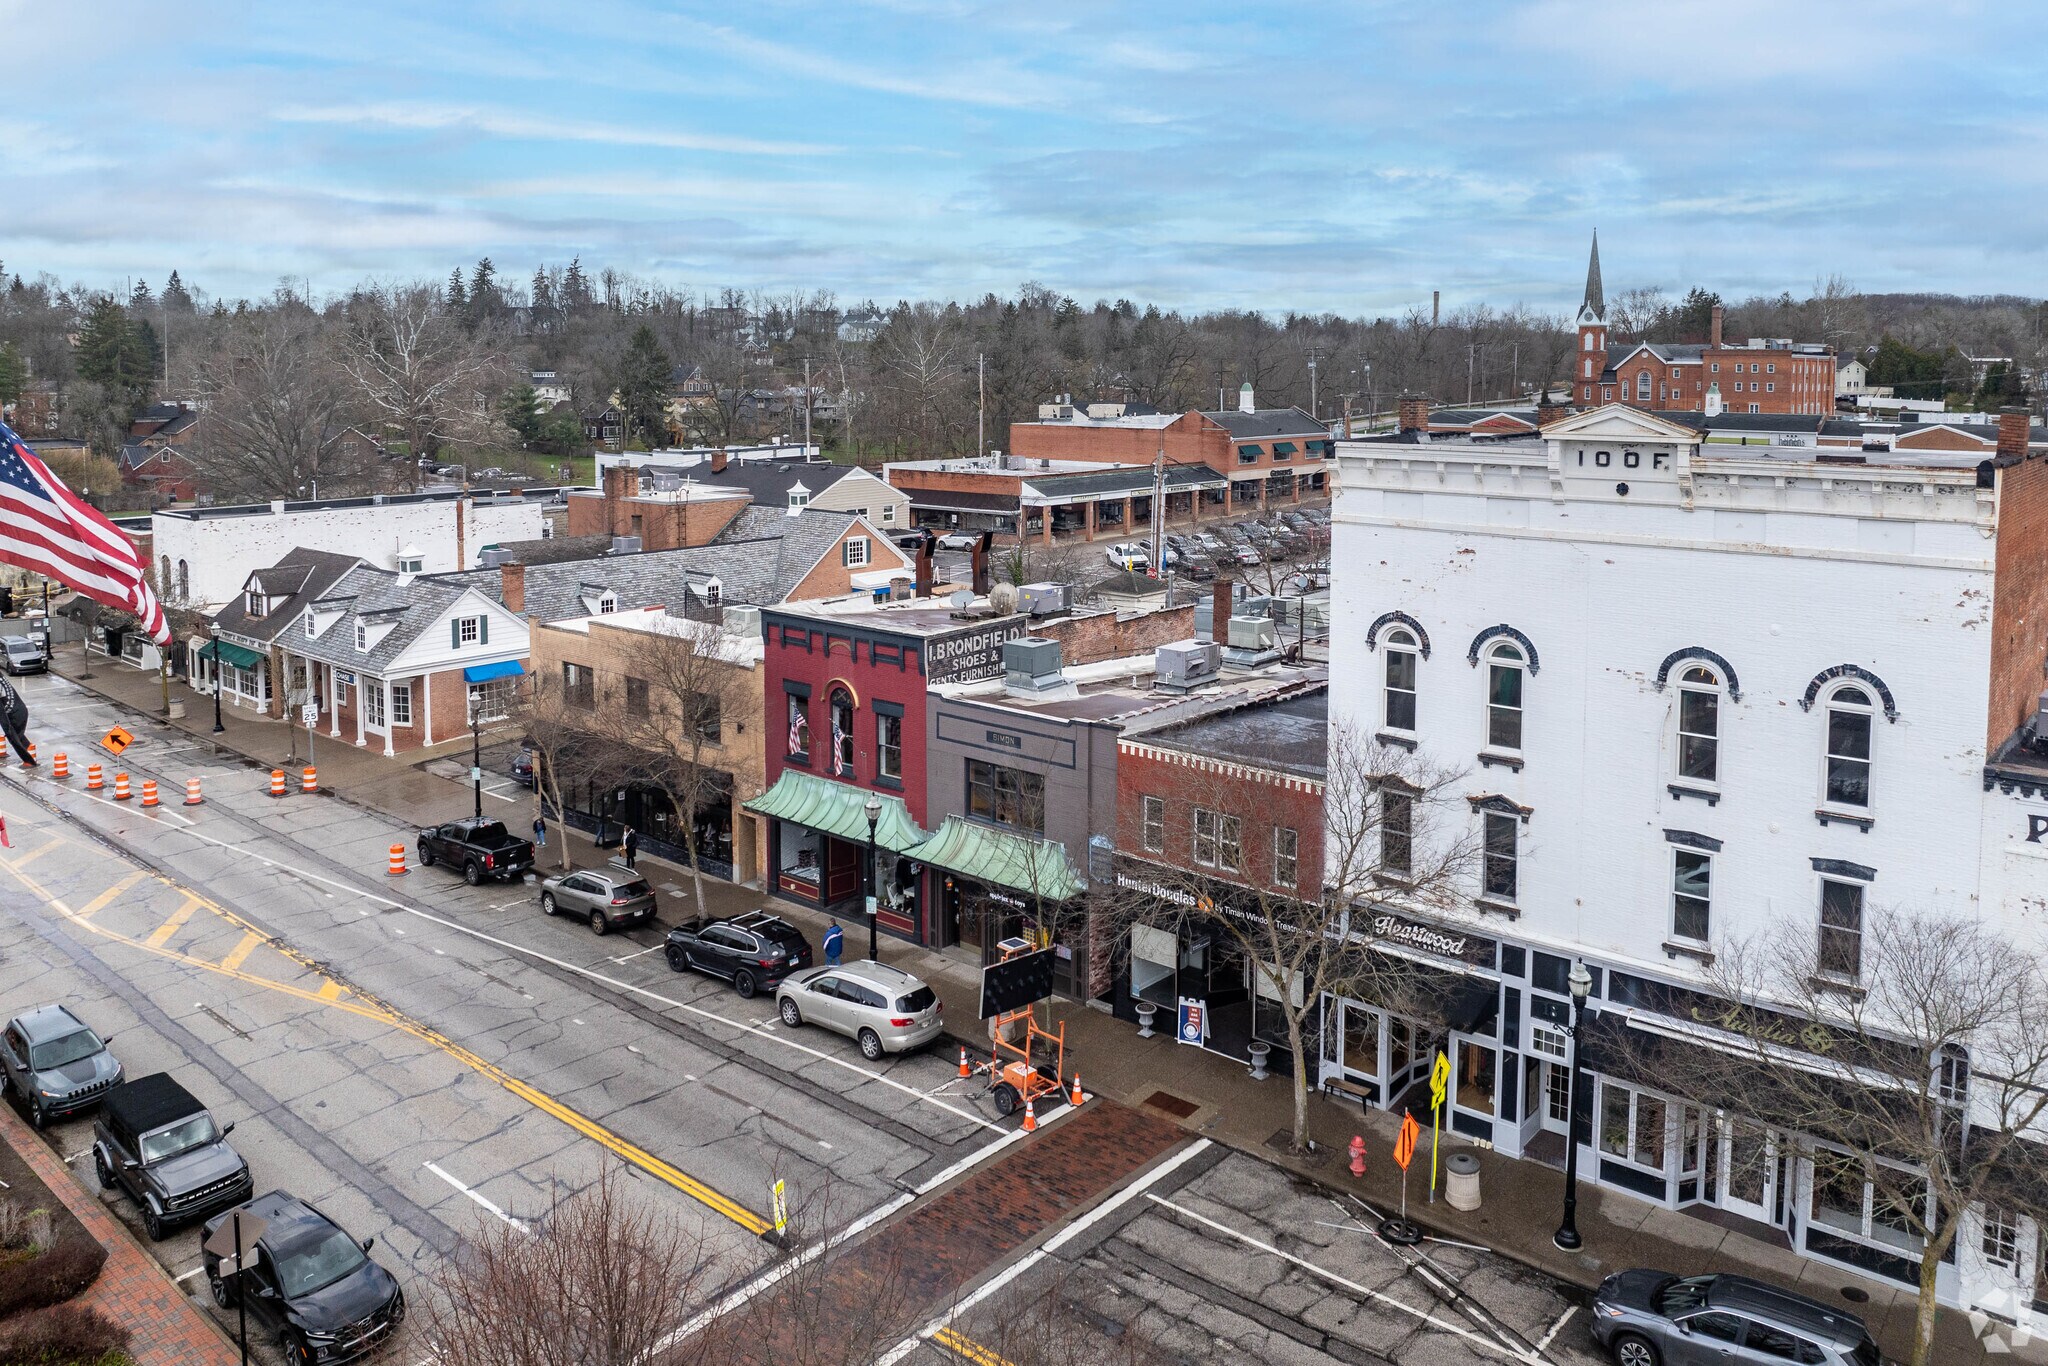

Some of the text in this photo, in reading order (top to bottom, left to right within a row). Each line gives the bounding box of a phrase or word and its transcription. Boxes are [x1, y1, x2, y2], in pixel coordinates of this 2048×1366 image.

[952, 650, 999, 670] SHOES &
[303, 712, 317, 721] 25
[992, 733, 1015, 745] SIMON
[1374, 915, 1467, 955] Heartwood
